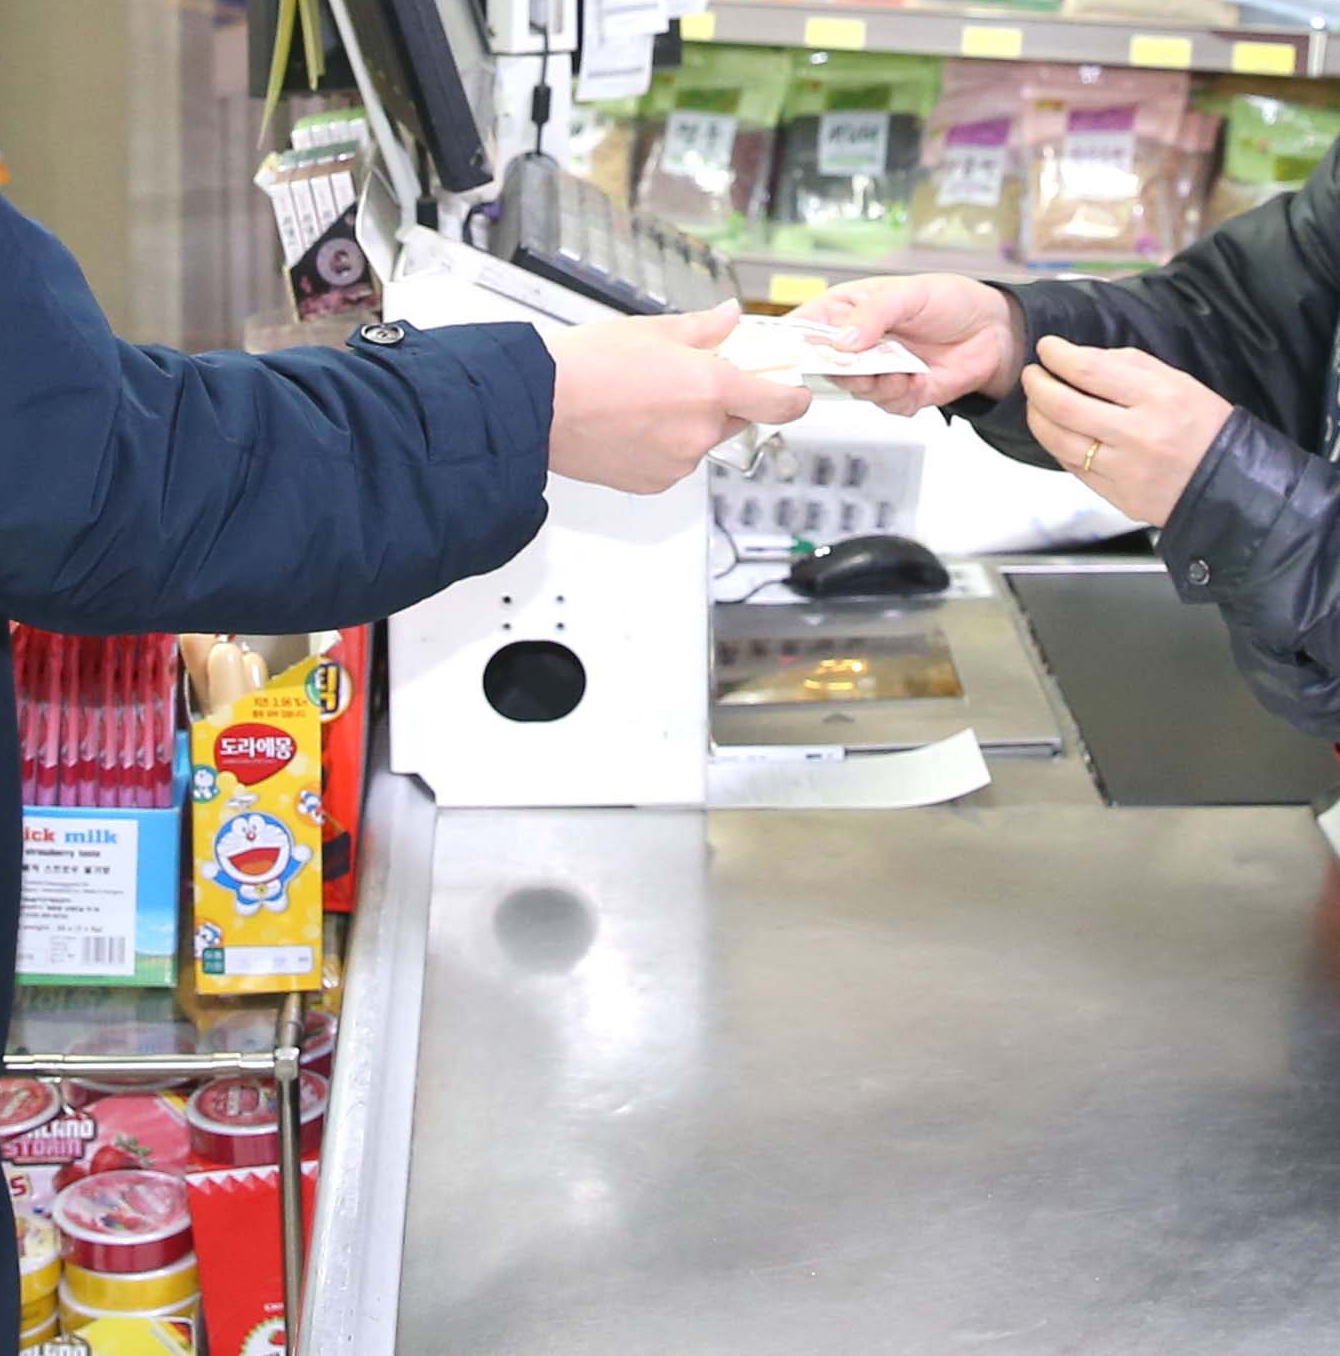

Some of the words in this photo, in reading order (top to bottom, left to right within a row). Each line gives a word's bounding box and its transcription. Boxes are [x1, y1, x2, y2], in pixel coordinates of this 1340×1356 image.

[220, 736, 293, 761] 도라에몽
[24, 826, 56, 843] ick
[64, 829, 118, 844] milk
[26, 1118, 95, 1139] LAND
